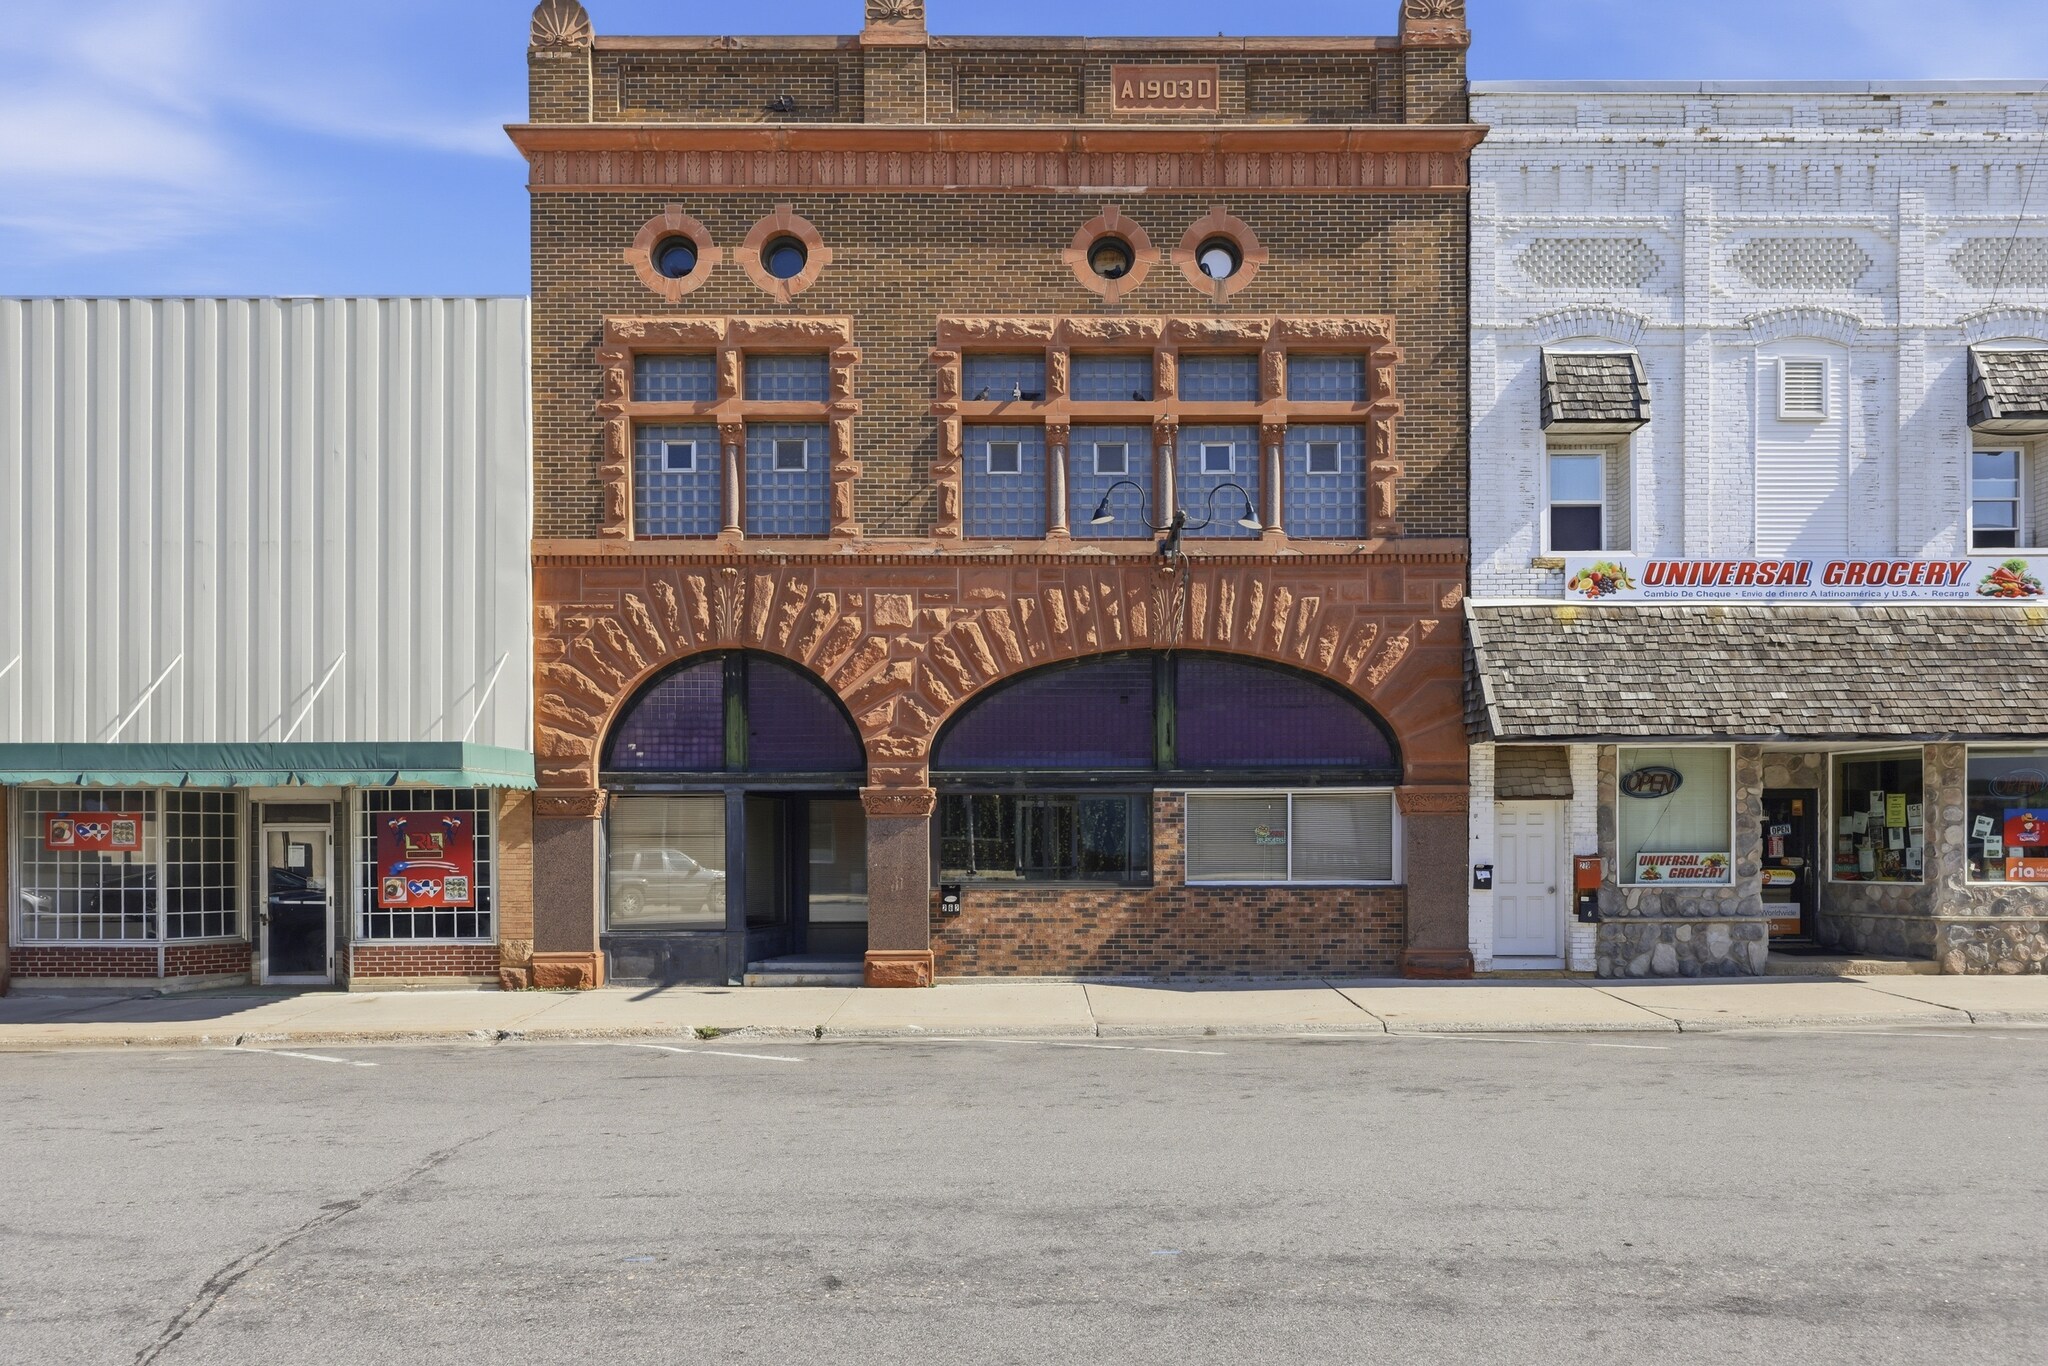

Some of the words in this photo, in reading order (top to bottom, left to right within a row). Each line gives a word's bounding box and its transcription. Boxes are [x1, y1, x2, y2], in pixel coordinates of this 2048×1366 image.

[1642, 560, 1812, 587] UNIVERSAL
[1821, 560, 1971, 587] GROCERY
[1643, 590, 1679, 598] Cambio
[1681, 590, 1694, 598] De
[1696, 590, 1731, 599] Cheque
[1765, 590, 1777, 598] de
[1779, 590, 1808, 598] dinero
[1810, 590, 1817, 598] A
[1819, 590, 1882, 598] latinoamérica
[1892, 590, 1920, 598] U.S.A.
[1628, 773, 1675, 793] OPEN
[1996, 775, 2042, 793] OPEN
[1771, 825, 1790, 834] OPEN
[1639, 855, 1699, 866] UNIVERSAL
[1668, 867, 1726, 879] GROCERY
[2009, 861, 2035, 878] ria
